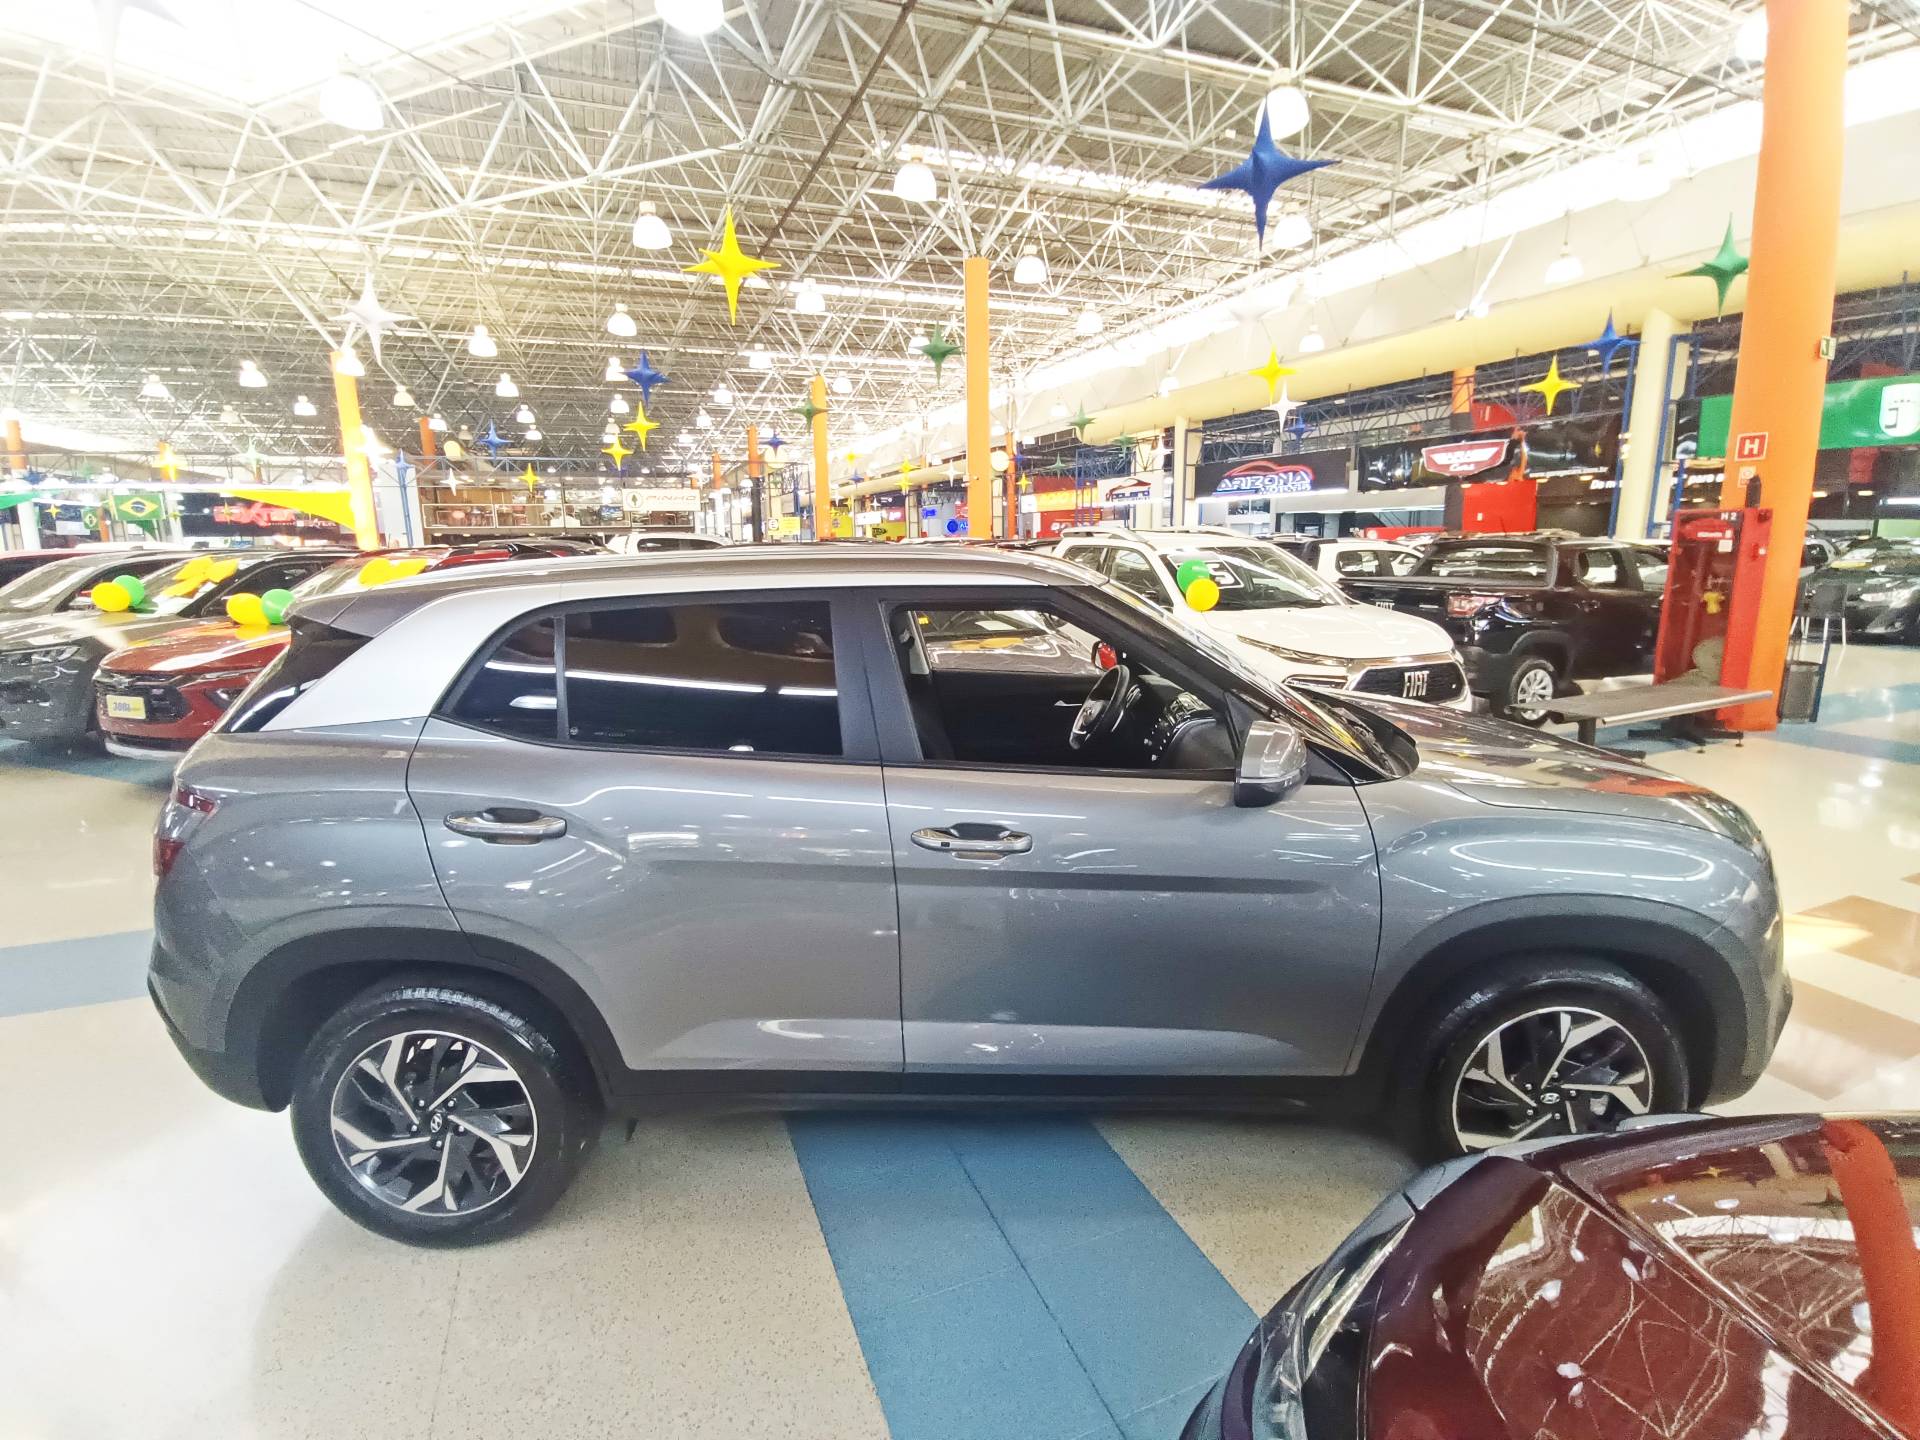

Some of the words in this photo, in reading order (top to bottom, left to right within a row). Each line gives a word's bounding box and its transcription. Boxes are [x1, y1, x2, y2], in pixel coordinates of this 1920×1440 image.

[1743, 438, 1760, 455] H
[1720, 512, 1729, 520] H
[1730, 512, 1737, 520] 2
[1402, 670, 1429, 698] FIAT
